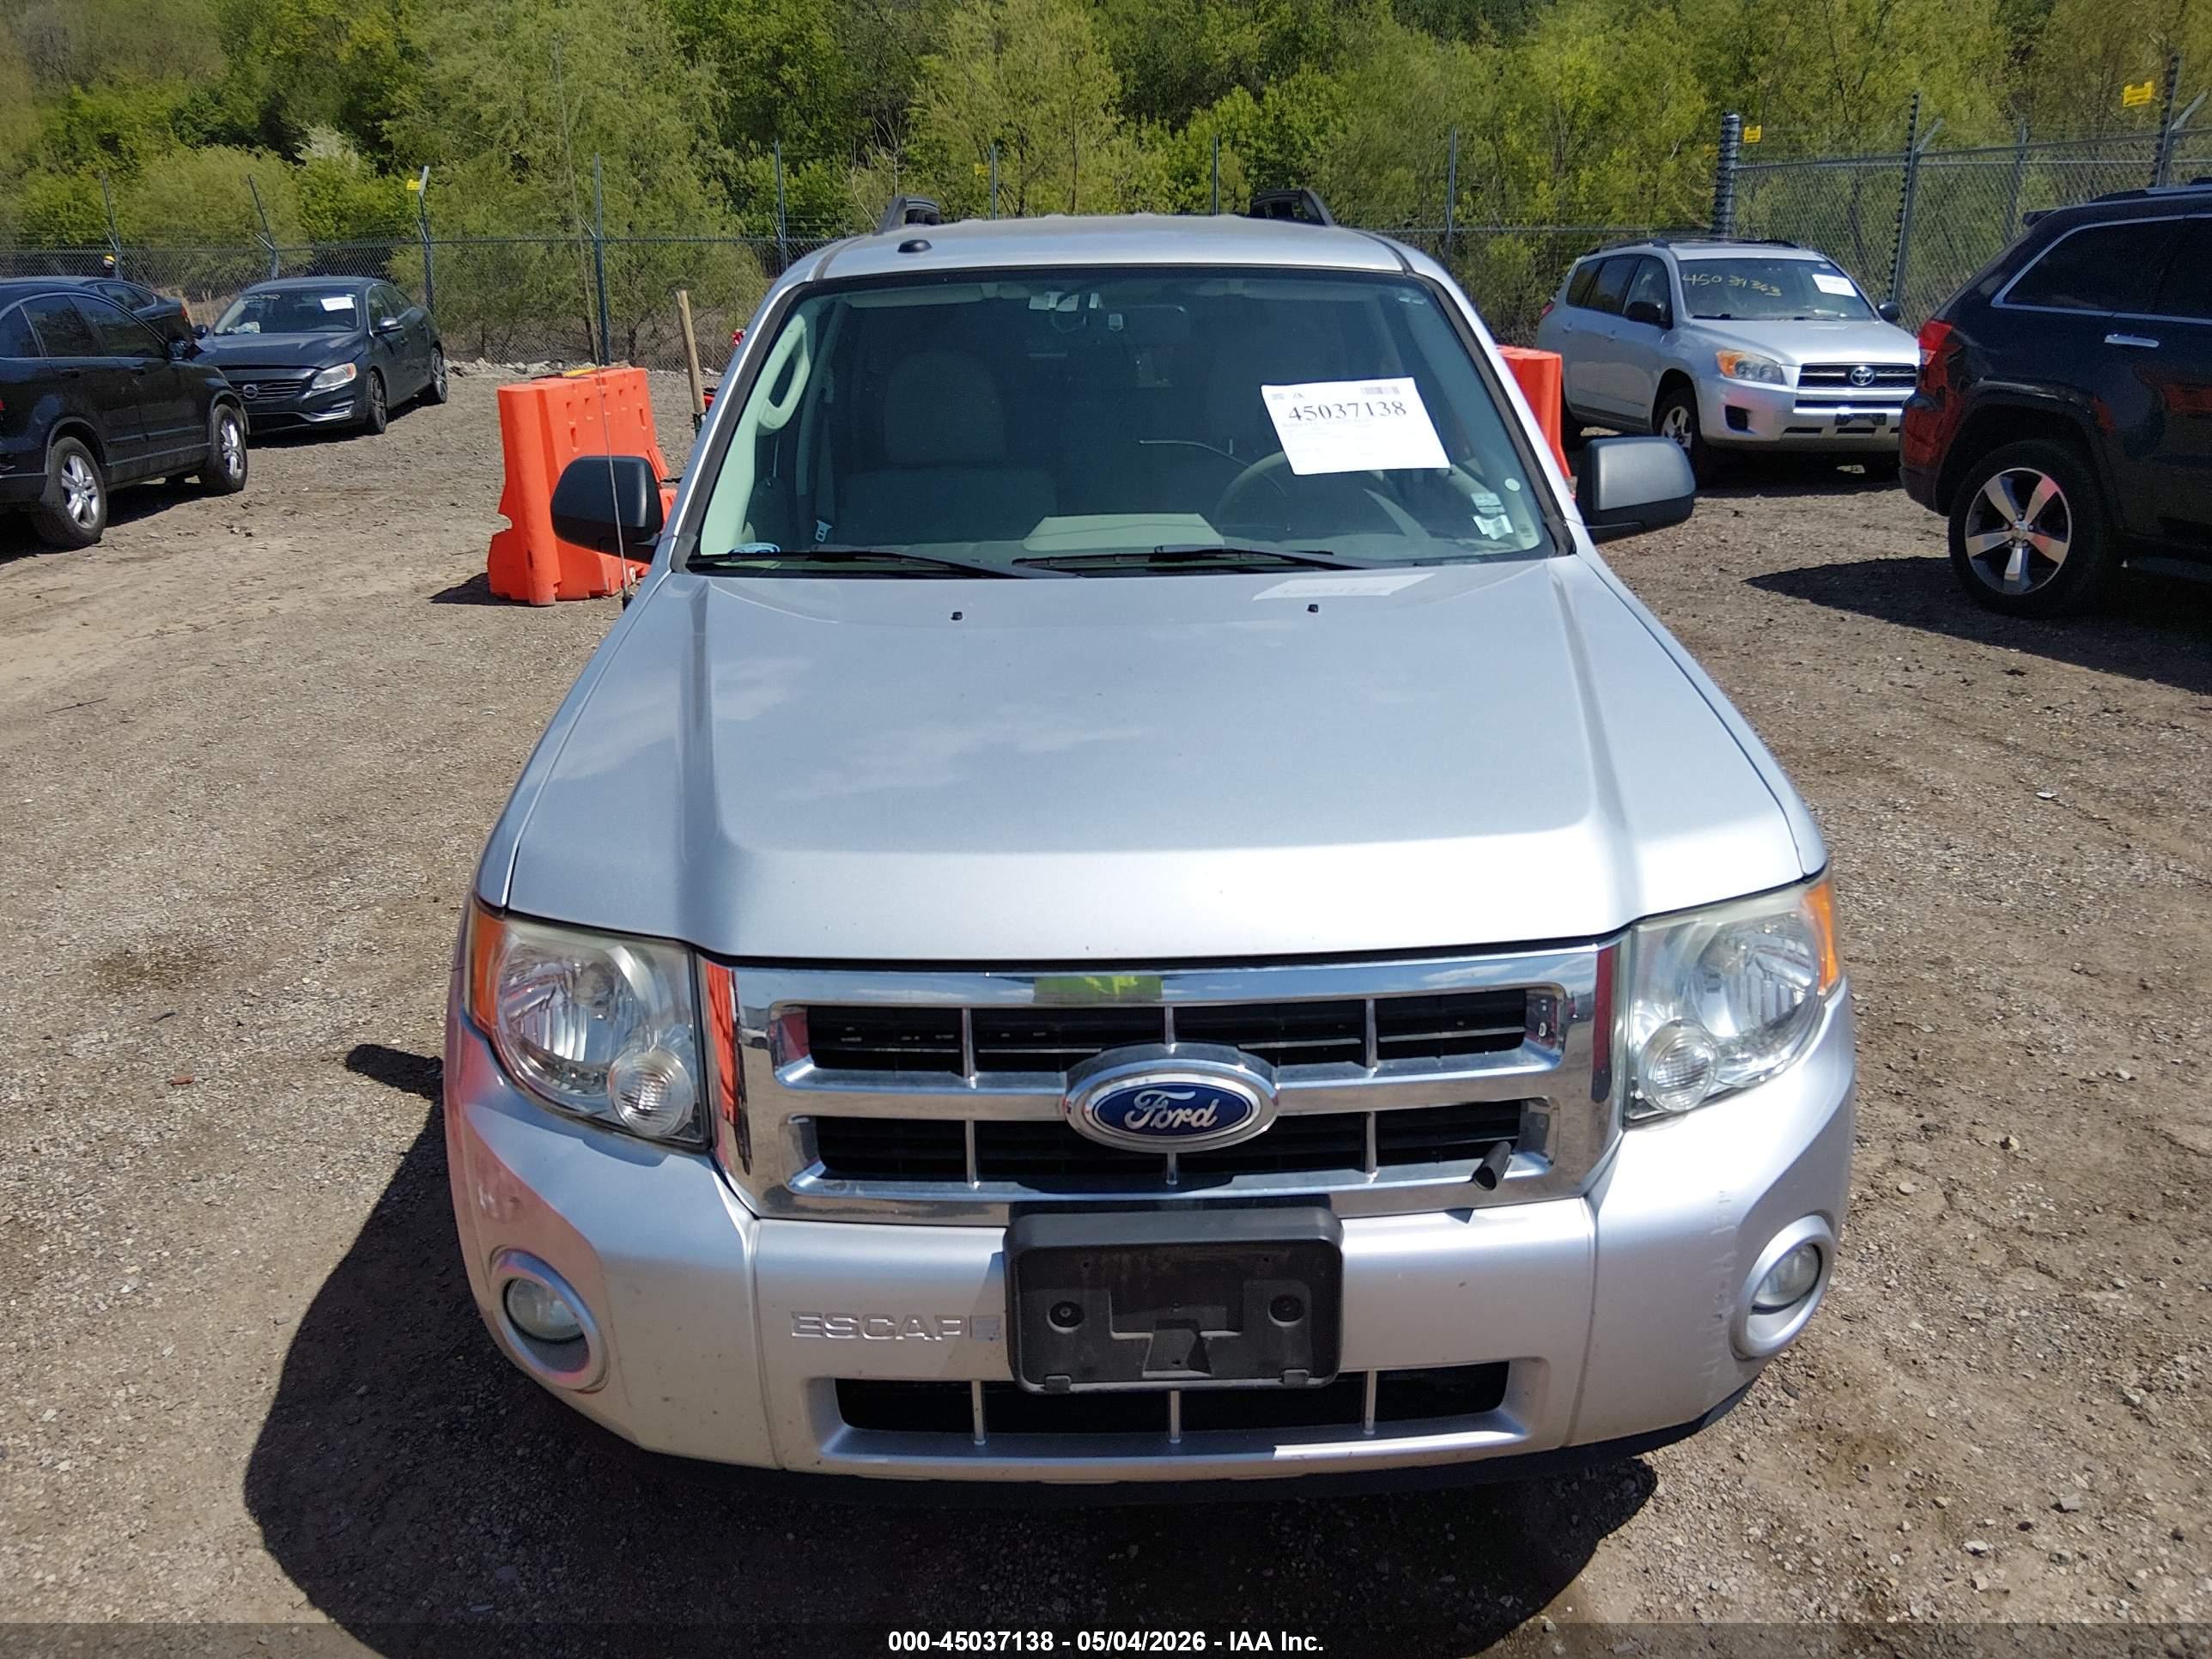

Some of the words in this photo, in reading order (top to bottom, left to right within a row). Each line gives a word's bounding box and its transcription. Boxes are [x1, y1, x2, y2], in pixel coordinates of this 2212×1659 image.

[1288, 399, 1407, 421] 45037138
[1124, 1090, 1220, 1130] Ford
[791, 1312, 1001, 1340] ESCAPE
